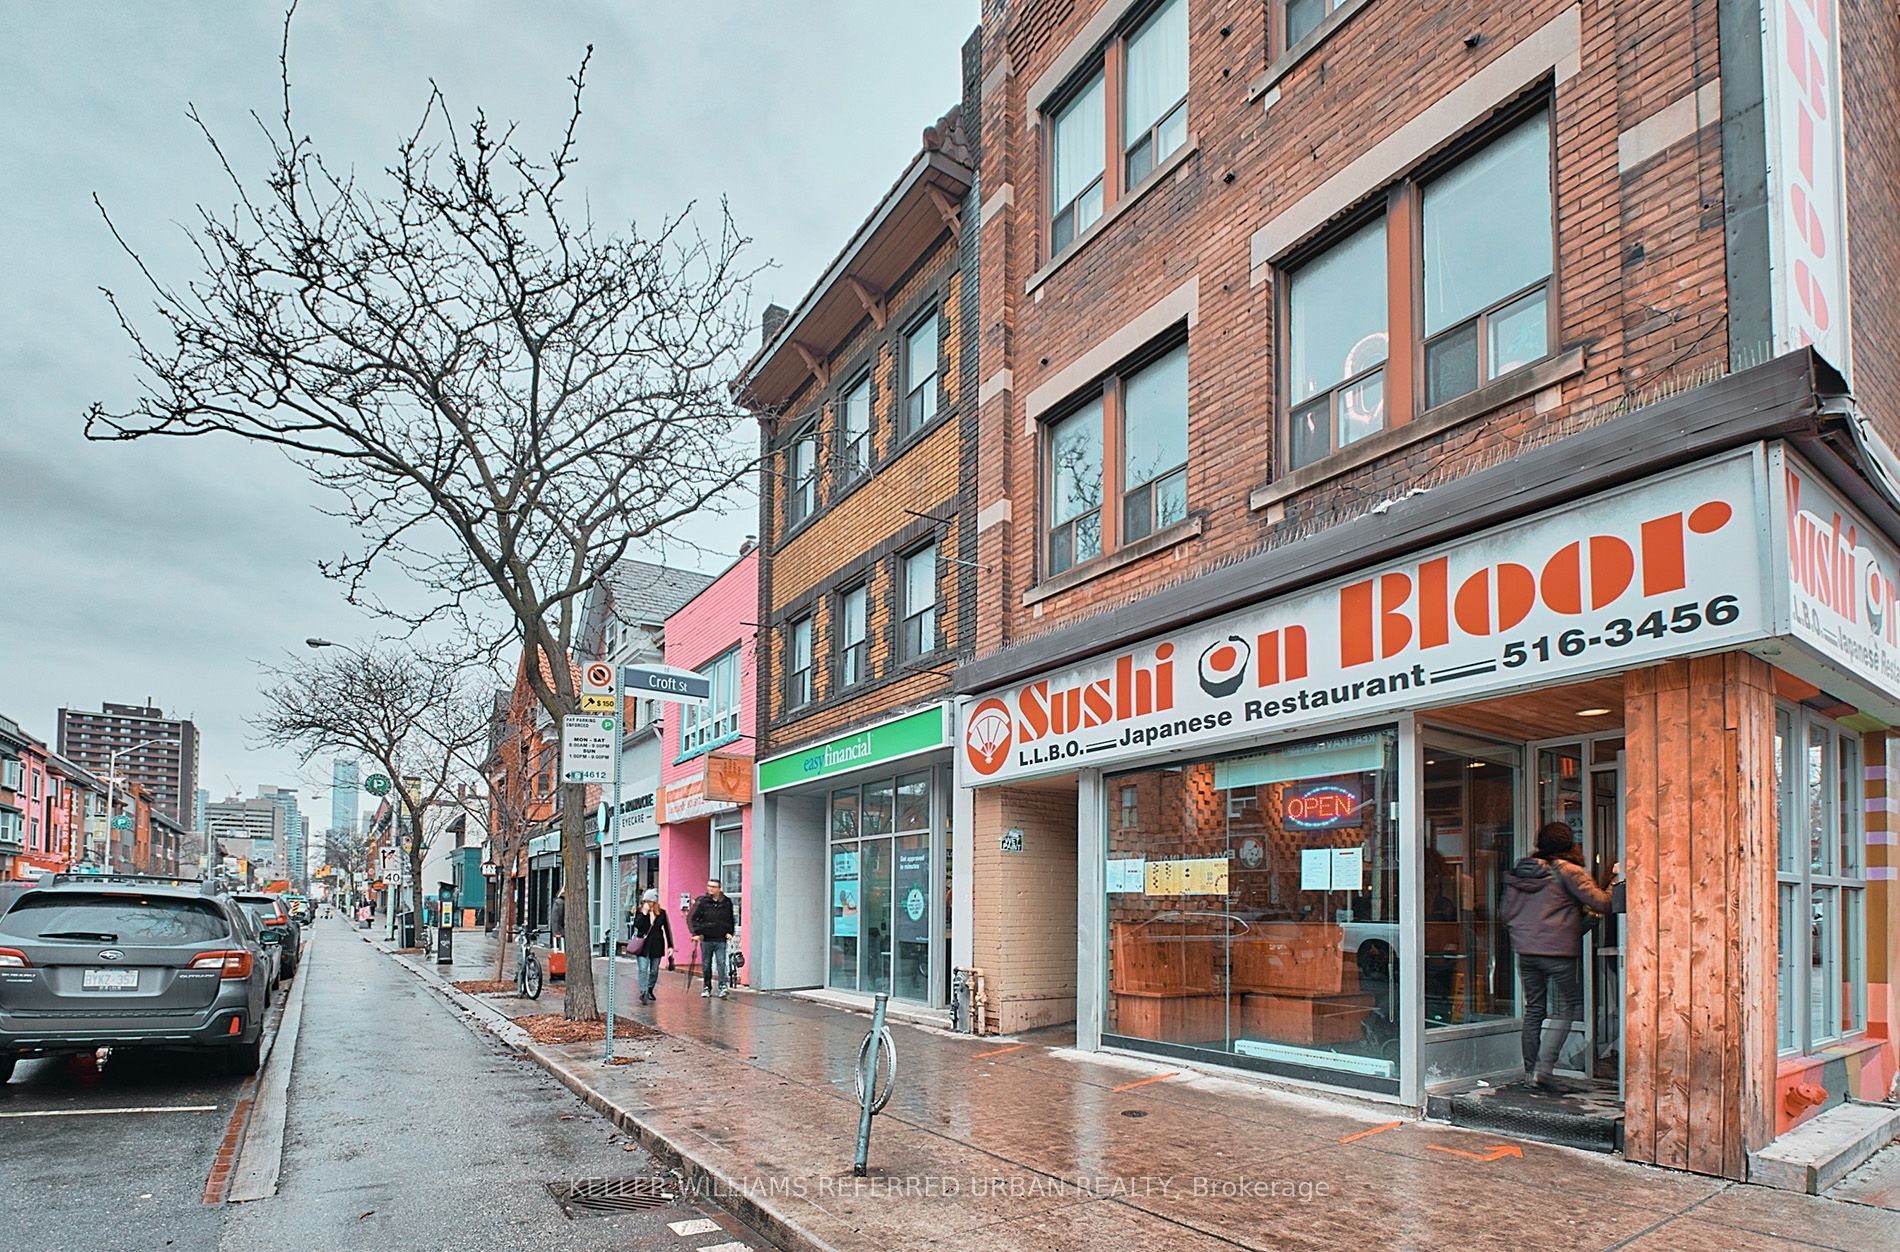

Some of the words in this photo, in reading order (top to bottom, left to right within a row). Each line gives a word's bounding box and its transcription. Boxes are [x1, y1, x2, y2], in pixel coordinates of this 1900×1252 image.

[1018, 641, 1175, 744] Sushi
[1340, 500, 1733, 669] Bloor
[649, 675, 677, 689] Croft
[679, 682, 688, 692] St
[1018, 740, 1084, 767] L.L.B.O.
[1120, 709, 1233, 747] Japanese
[1244, 663, 1425, 722] Restaurant
[1502, 594, 1739, 668] 516-3456
[583, 771, 607, 779] 4612
[1288, 794, 1351, 818] OPEN
[622, 813, 645, 828] EYECARE
[385, 873, 400, 882] 40
